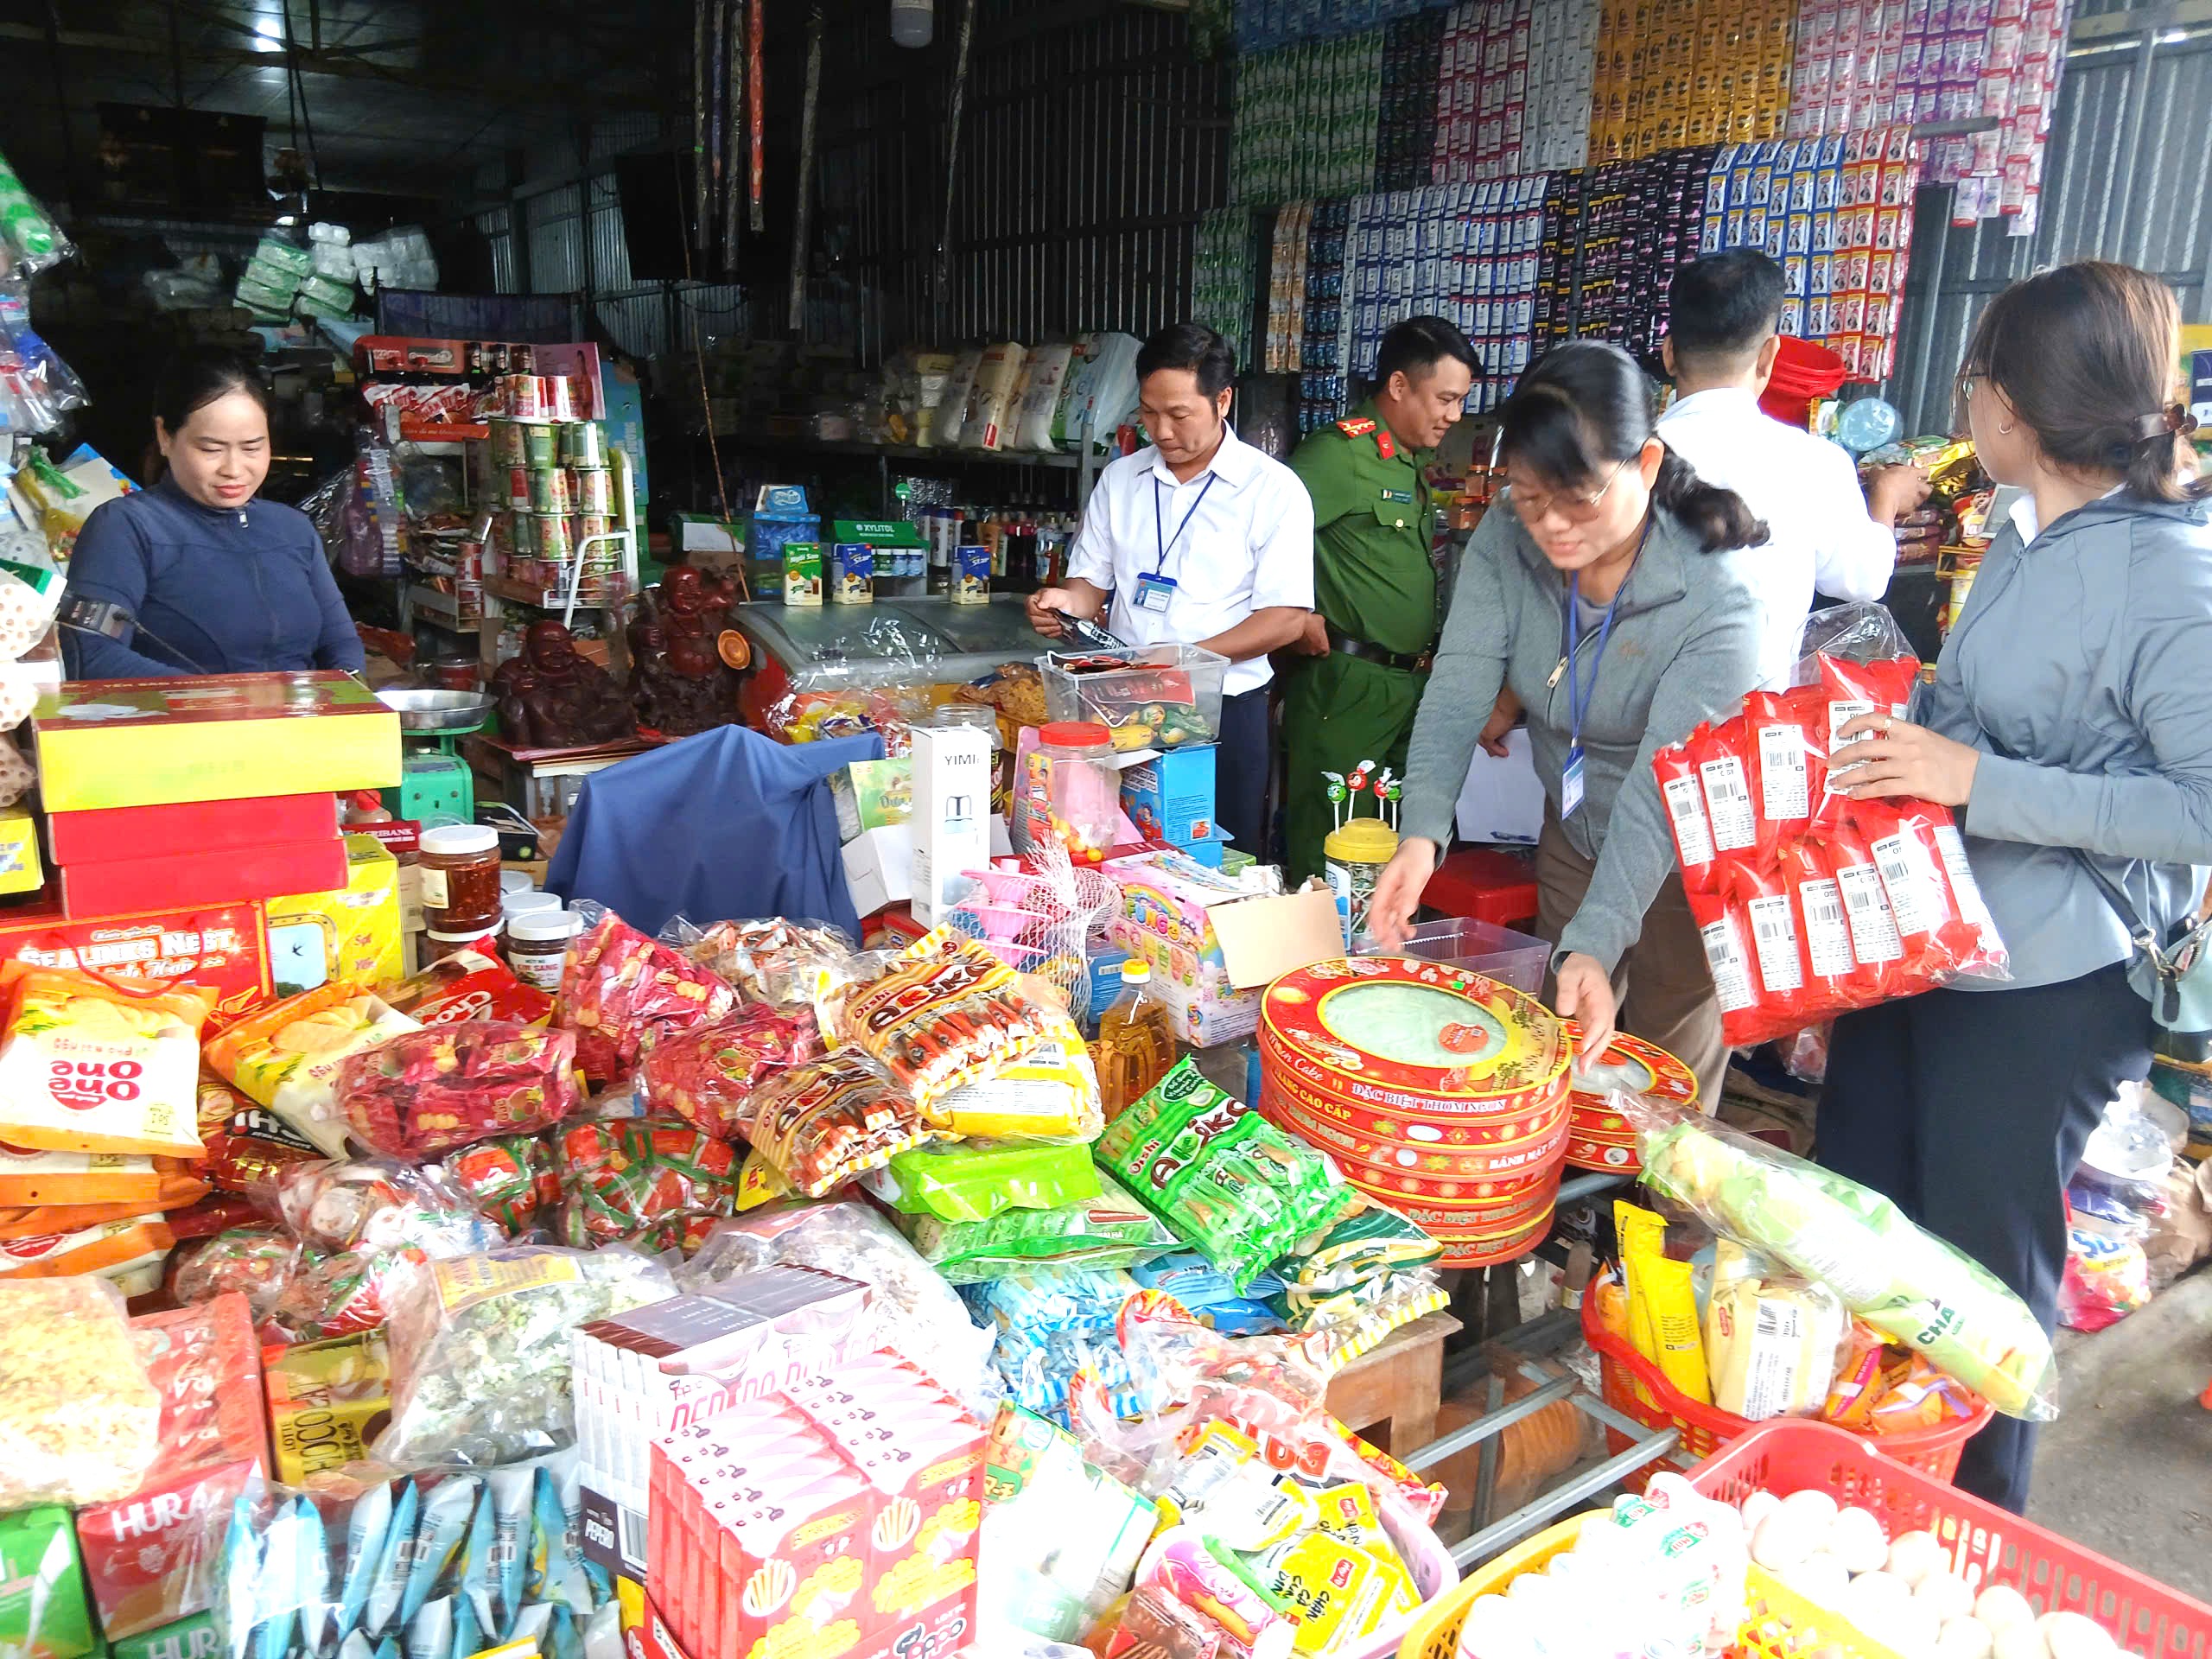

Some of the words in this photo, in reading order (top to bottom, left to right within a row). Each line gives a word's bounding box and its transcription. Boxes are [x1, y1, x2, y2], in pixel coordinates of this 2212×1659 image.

[864, 524, 895, 532] XYLITOL
[356, 829, 415, 838] RIBANK
[855, 989, 892, 1020] Oishi
[49, 1059, 143, 1079] One
[1294, 1058, 1325, 1082] Cake
[48, 1077, 141, 1101] One
[1299, 1090, 1324, 1109] CAO
[1324, 1102, 1353, 1122] CẤP
[1128, 1139, 1161, 1175] Oishi
